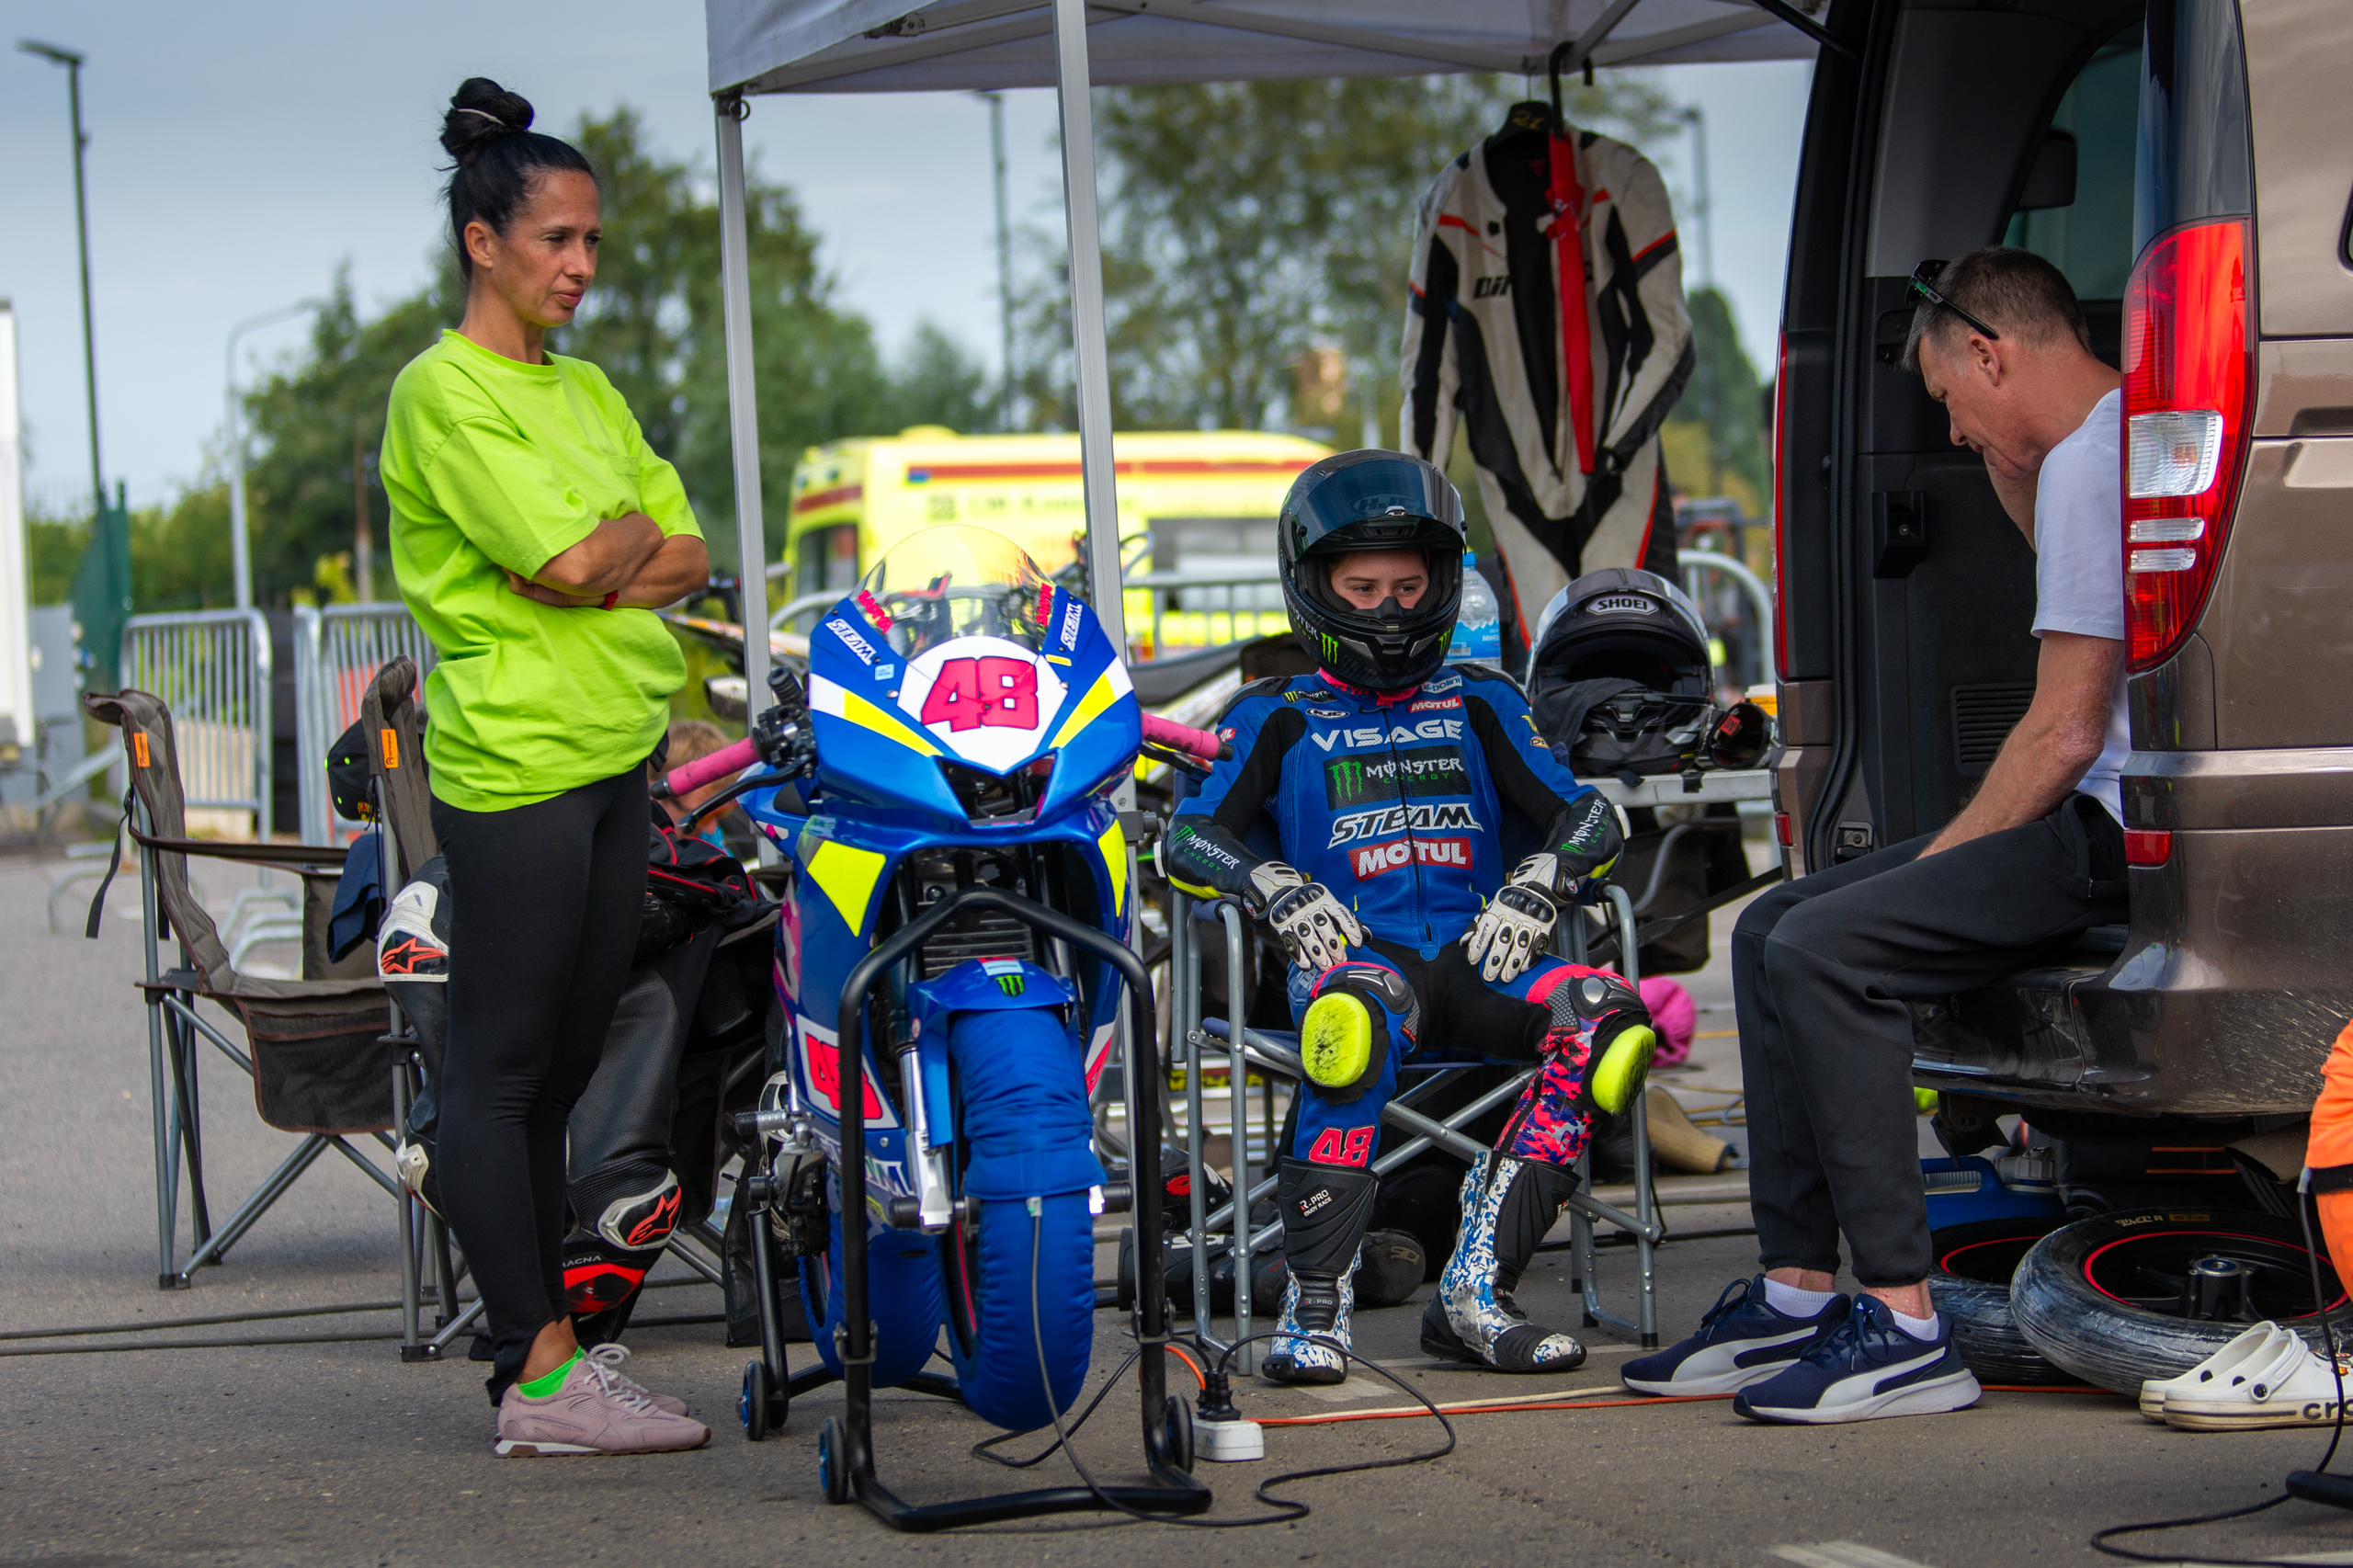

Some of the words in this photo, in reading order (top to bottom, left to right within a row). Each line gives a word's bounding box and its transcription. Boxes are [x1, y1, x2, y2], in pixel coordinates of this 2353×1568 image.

[856, 590, 893, 634] SANYA
[1597, 598, 1648, 610] SHOEI
[825, 619, 877, 665] STEAM
[1061, 602, 1083, 652] STEAM
[921, 656, 1039, 733] 48
[1432, 676, 1461, 692] polini
[1411, 698, 1460, 711] MOTUL
[1311, 719, 1463, 752] VISAGE
[1366, 757, 1465, 779] MONSTER
[1383, 772, 1449, 784] ENERGY
[1327, 802, 1484, 849] STEAM
[1568, 799, 1607, 846] MONSTER
[1184, 847, 1222, 871] ENERGY
[1186, 834, 1240, 869] MONSTER
[1358, 839, 1467, 877] MOTUL
[1308, 1124, 1377, 1167] 48
[1299, 1189, 1329, 1210] R-PRO
[1318, 1197, 1333, 1209] RACE
[563, 1256, 602, 1267] ACNA
